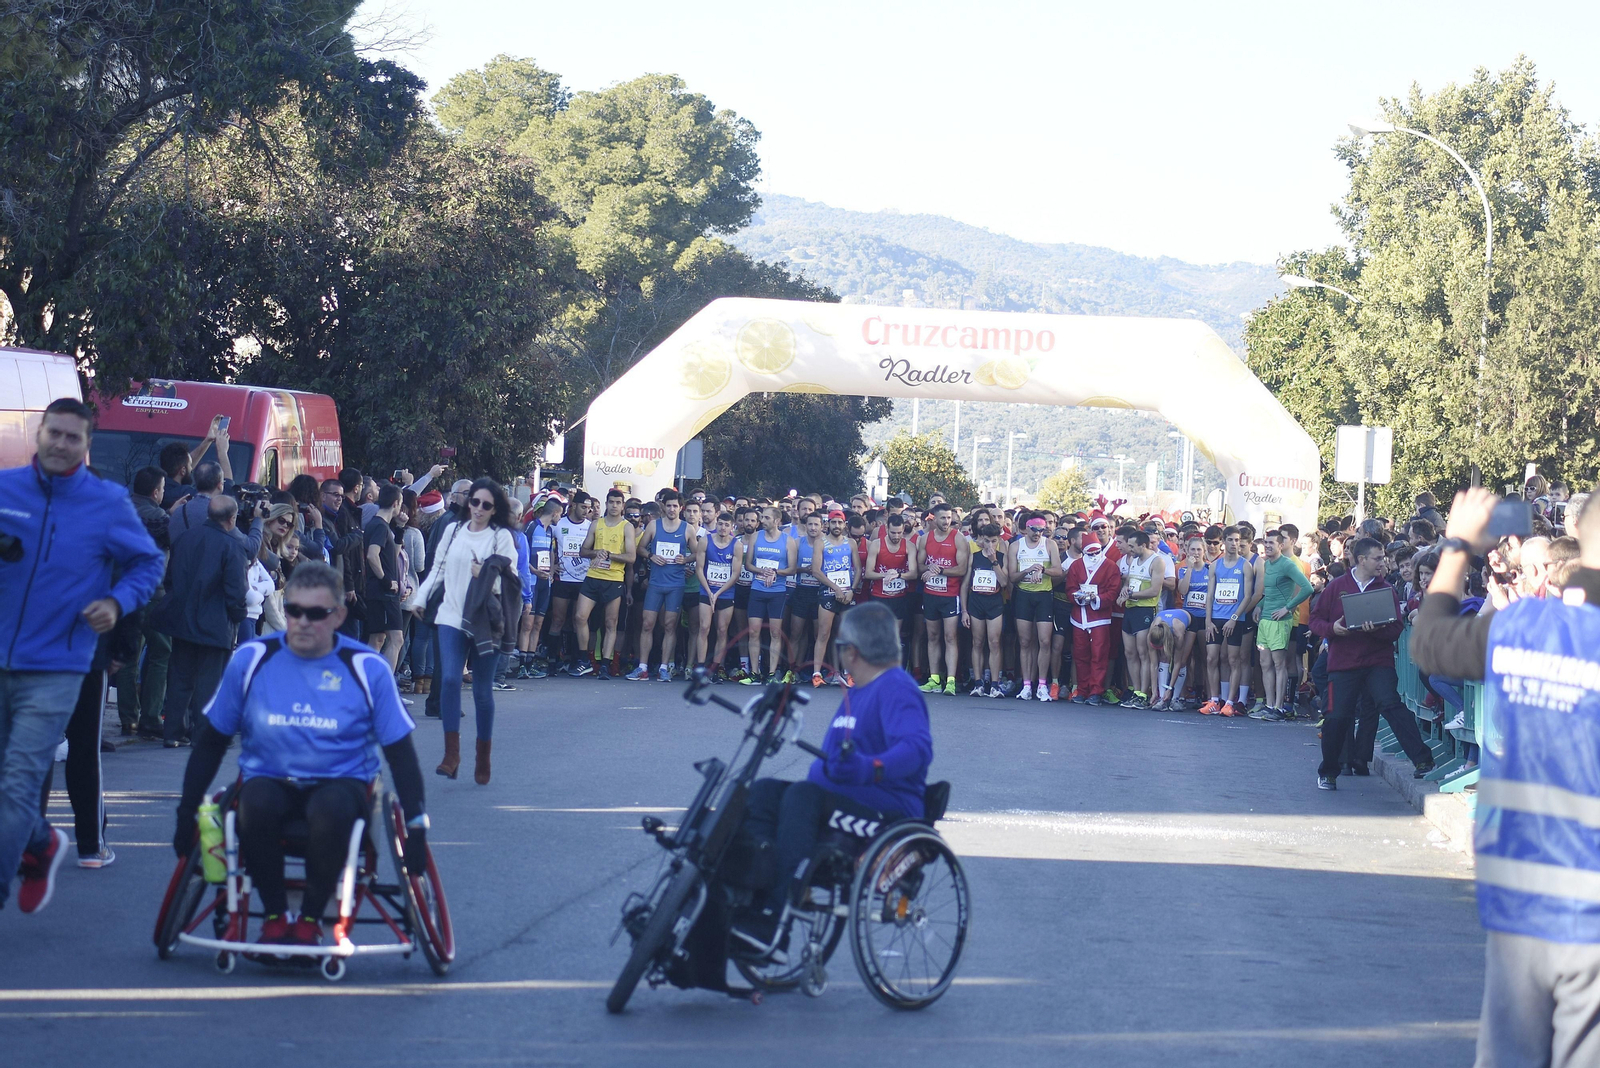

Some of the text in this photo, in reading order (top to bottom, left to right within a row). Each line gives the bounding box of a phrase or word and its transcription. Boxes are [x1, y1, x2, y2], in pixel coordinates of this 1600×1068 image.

[862, 315, 1055, 356] Cruzcampo
[878, 355, 973, 387] Radler
[591, 441, 665, 460] Cruzcampo
[595, 460, 633, 475] Radler
[1238, 471, 1314, 492] Cruzcampo
[1243, 491, 1283, 505] Radler
[710, 572, 728, 580] 1243
[931, 577, 944, 585] 161
[977, 576, 992, 584] 675
[1191, 592, 1205, 601] 438
[292, 702, 314, 713] C.A.
[268, 714, 338, 729] BELALCÁZAR
